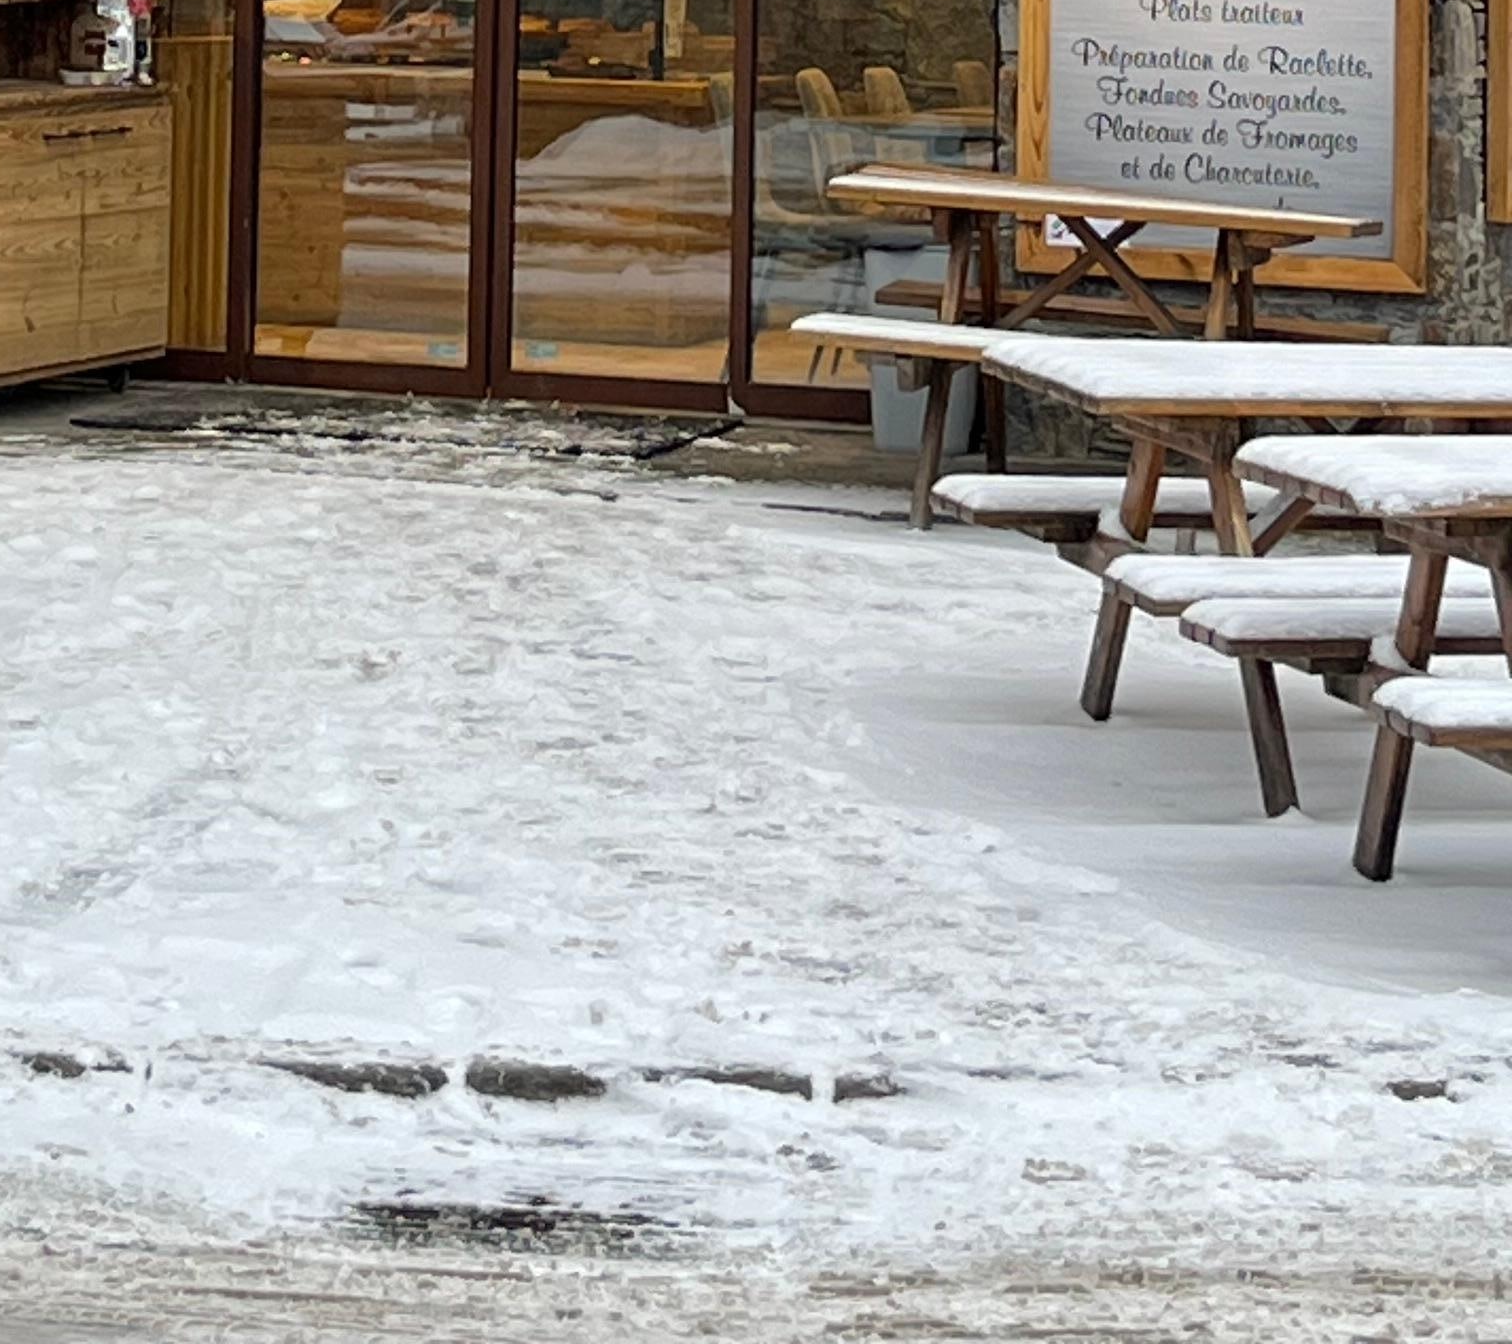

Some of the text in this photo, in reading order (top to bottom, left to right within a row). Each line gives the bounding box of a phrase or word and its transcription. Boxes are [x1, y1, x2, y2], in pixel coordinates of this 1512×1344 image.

[1221, 0, 1304, 25] traiteur
[1072, 37, 1214, 74] Préparation
[1223, 44, 1250, 72] de
[1085, 112, 1359, 159] Plateaux de Fromages
[1121, 155, 1139, 180] et
[1149, 153, 1175, 182] de
